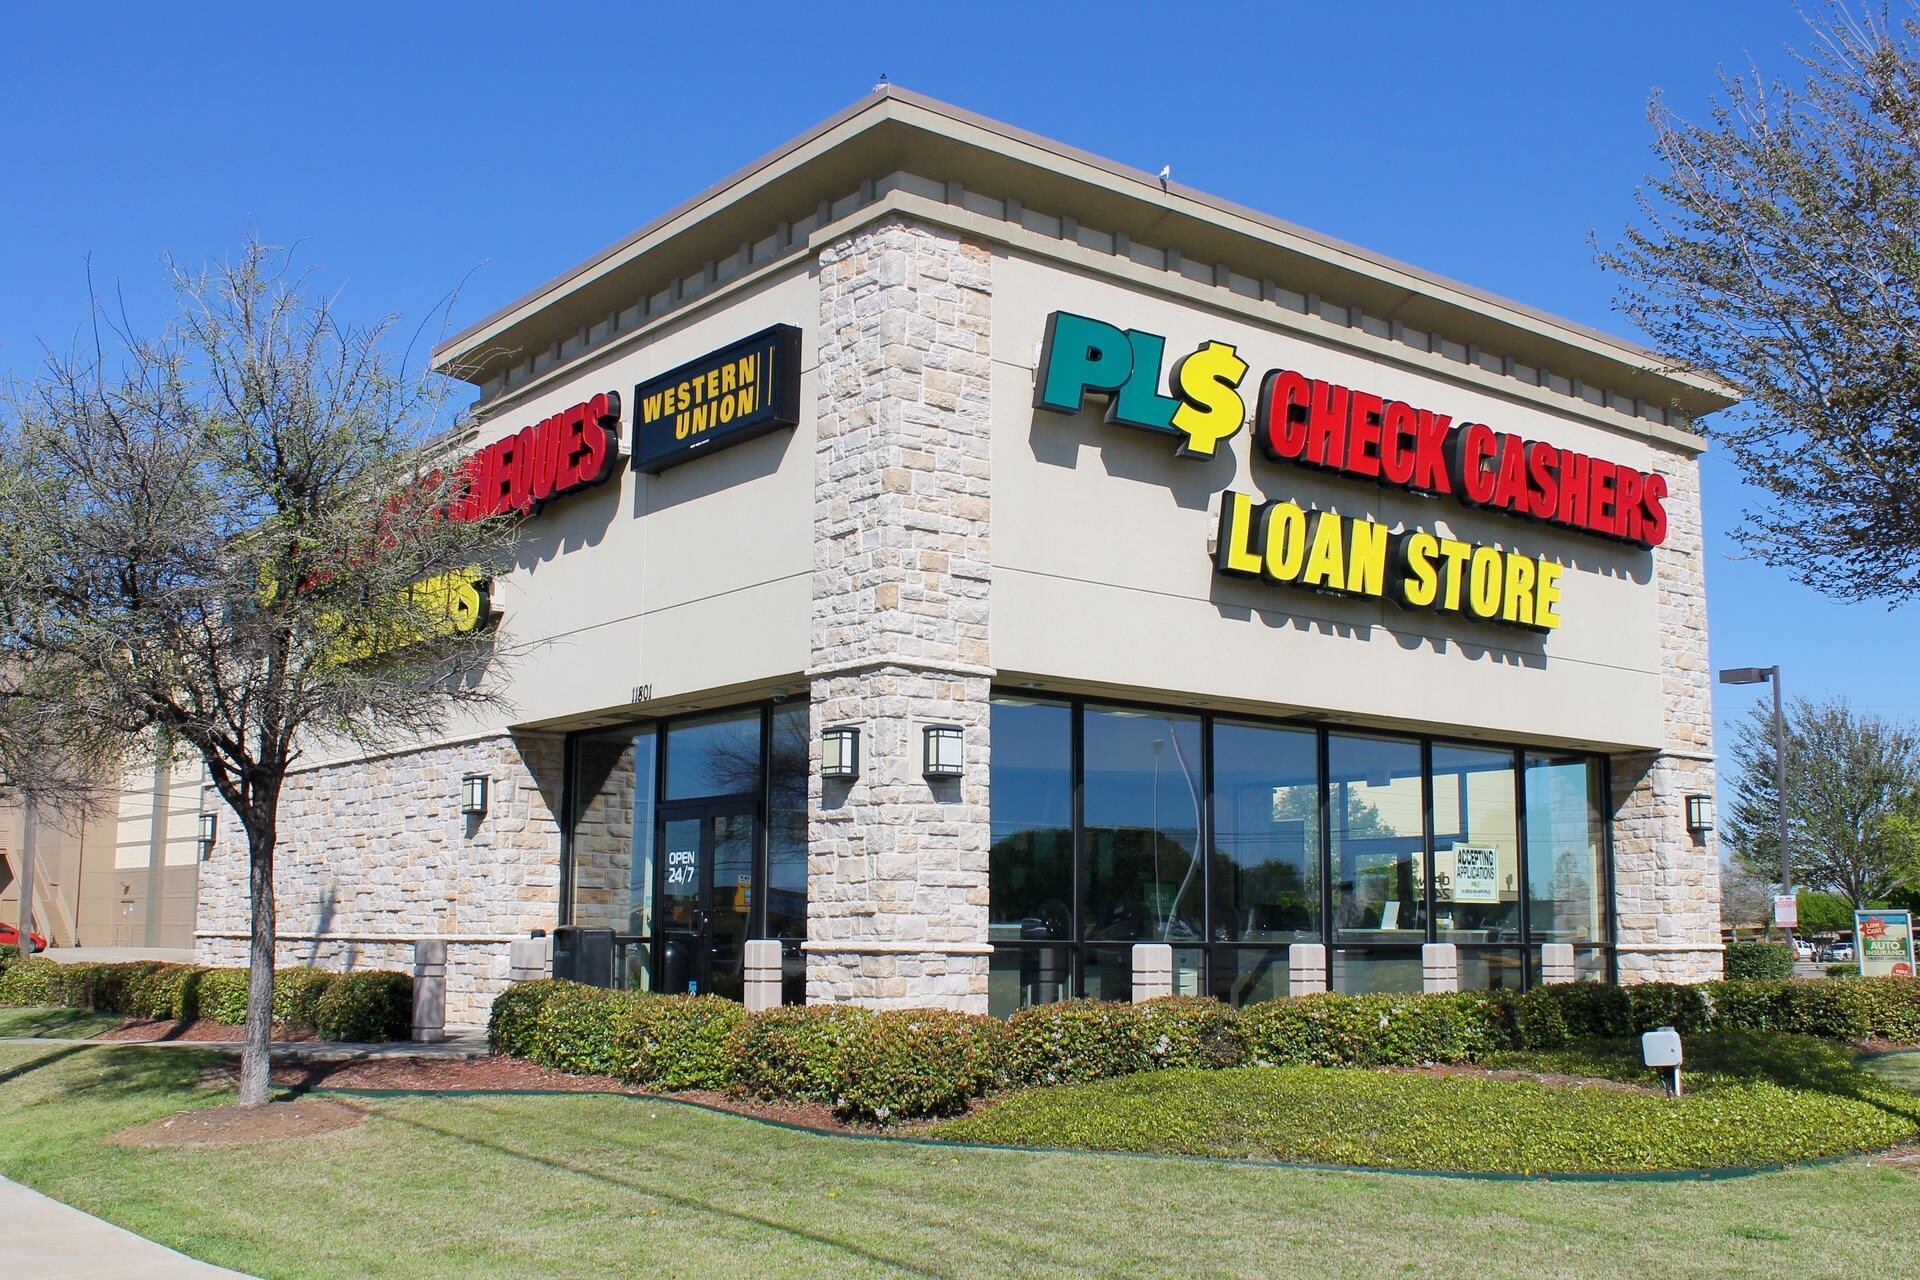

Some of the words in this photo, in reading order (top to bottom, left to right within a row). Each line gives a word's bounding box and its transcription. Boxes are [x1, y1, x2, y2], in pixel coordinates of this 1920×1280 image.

[643, 354, 755, 424] WESTERN
[675, 386, 754, 440] UNION
[1269, 370, 1453, 494] CHECK
[1464, 423, 1668, 545] CASHERS
[1227, 492, 1388, 596] LOAN
[1404, 533, 1564, 629] STORE
[631, 683, 652, 703] 11801
[669, 851, 695, 865] OPEN
[1457, 850, 1494, 866] ACCEPTING
[668, 865, 694, 884] 24/7
[1457, 866, 1494, 880] APPLICATIONS
[1870, 941, 1900, 950] AUTO
